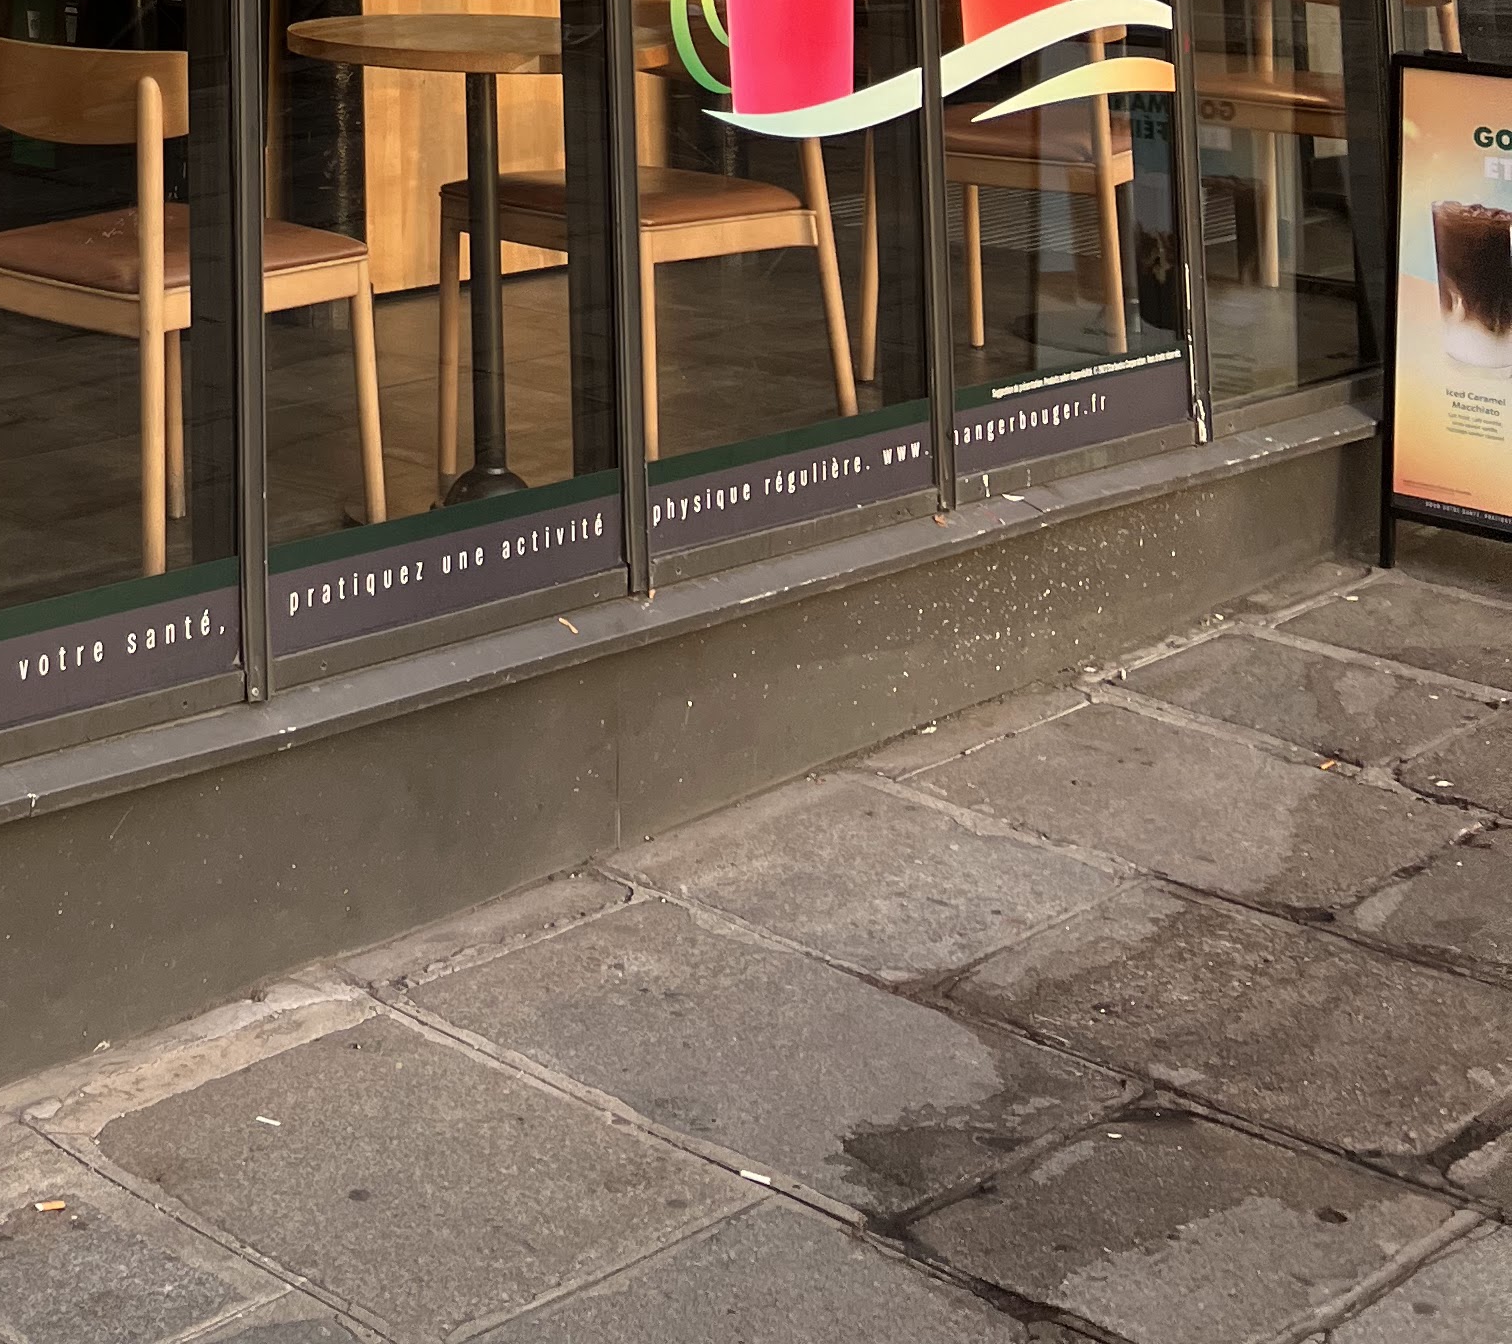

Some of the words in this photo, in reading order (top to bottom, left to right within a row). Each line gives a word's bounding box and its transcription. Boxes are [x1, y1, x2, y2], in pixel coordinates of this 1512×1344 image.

[1446, 388, 1466, 399] Iced
[1467, 391, 1506, 407] Caramel
[1452, 401, 1500, 418] Macchiato
[18, 637, 106, 682] votre
[126, 608, 228, 655] santé,
[288, 558, 425, 618] pratiquez
[441, 545, 488, 576] une
[500, 512, 606, 561] activité
[652, 480, 752, 526] physique
[763, 452, 871, 497] régulière.
